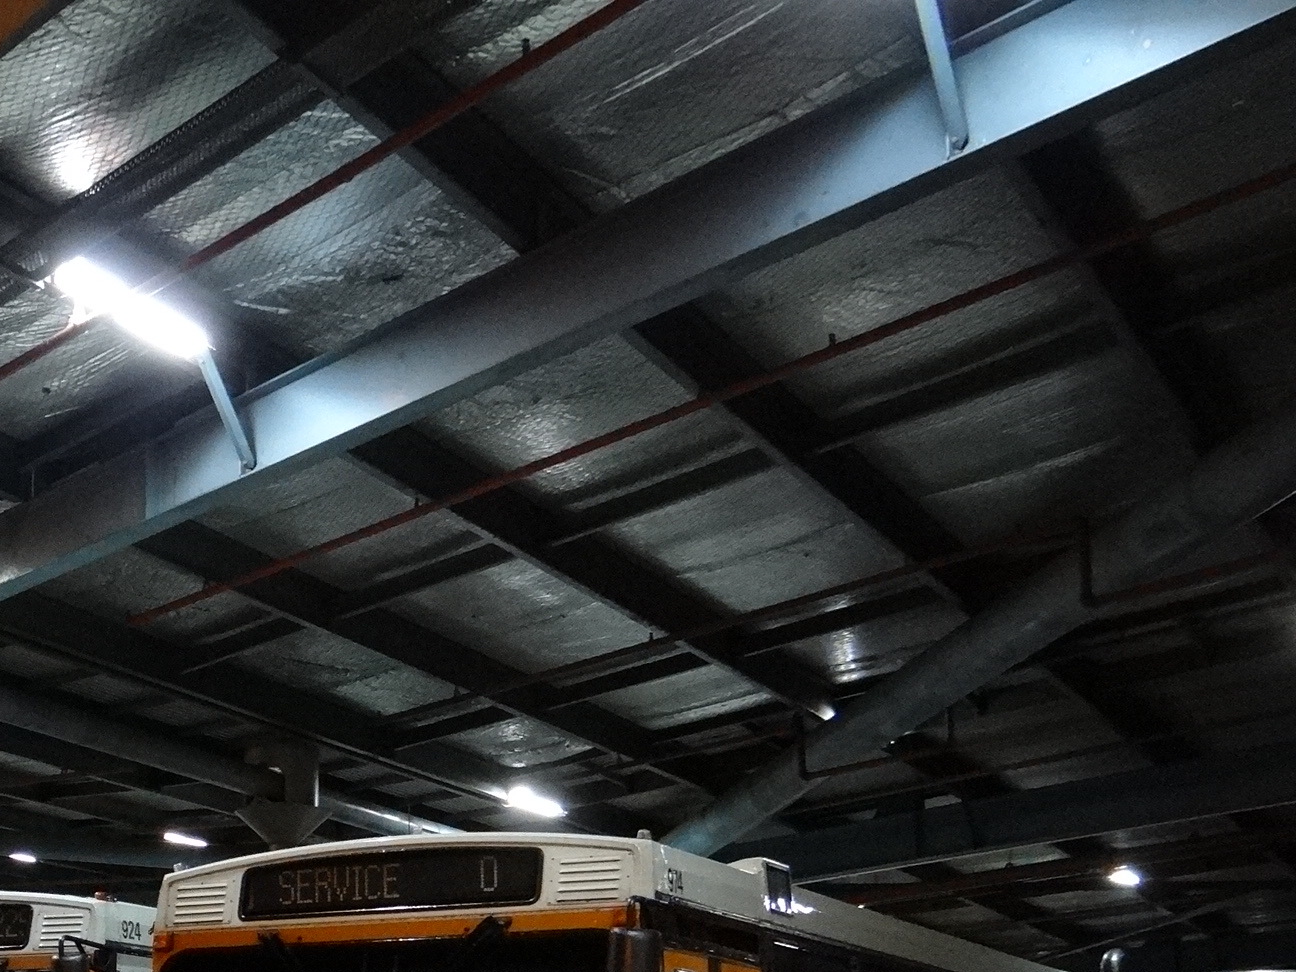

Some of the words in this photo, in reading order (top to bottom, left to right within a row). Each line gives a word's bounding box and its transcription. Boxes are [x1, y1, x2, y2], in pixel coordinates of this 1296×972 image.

[278, 862, 400, 906] SERVICE
[667, 868, 684, 894] 974
[121, 920, 142, 941] 924
